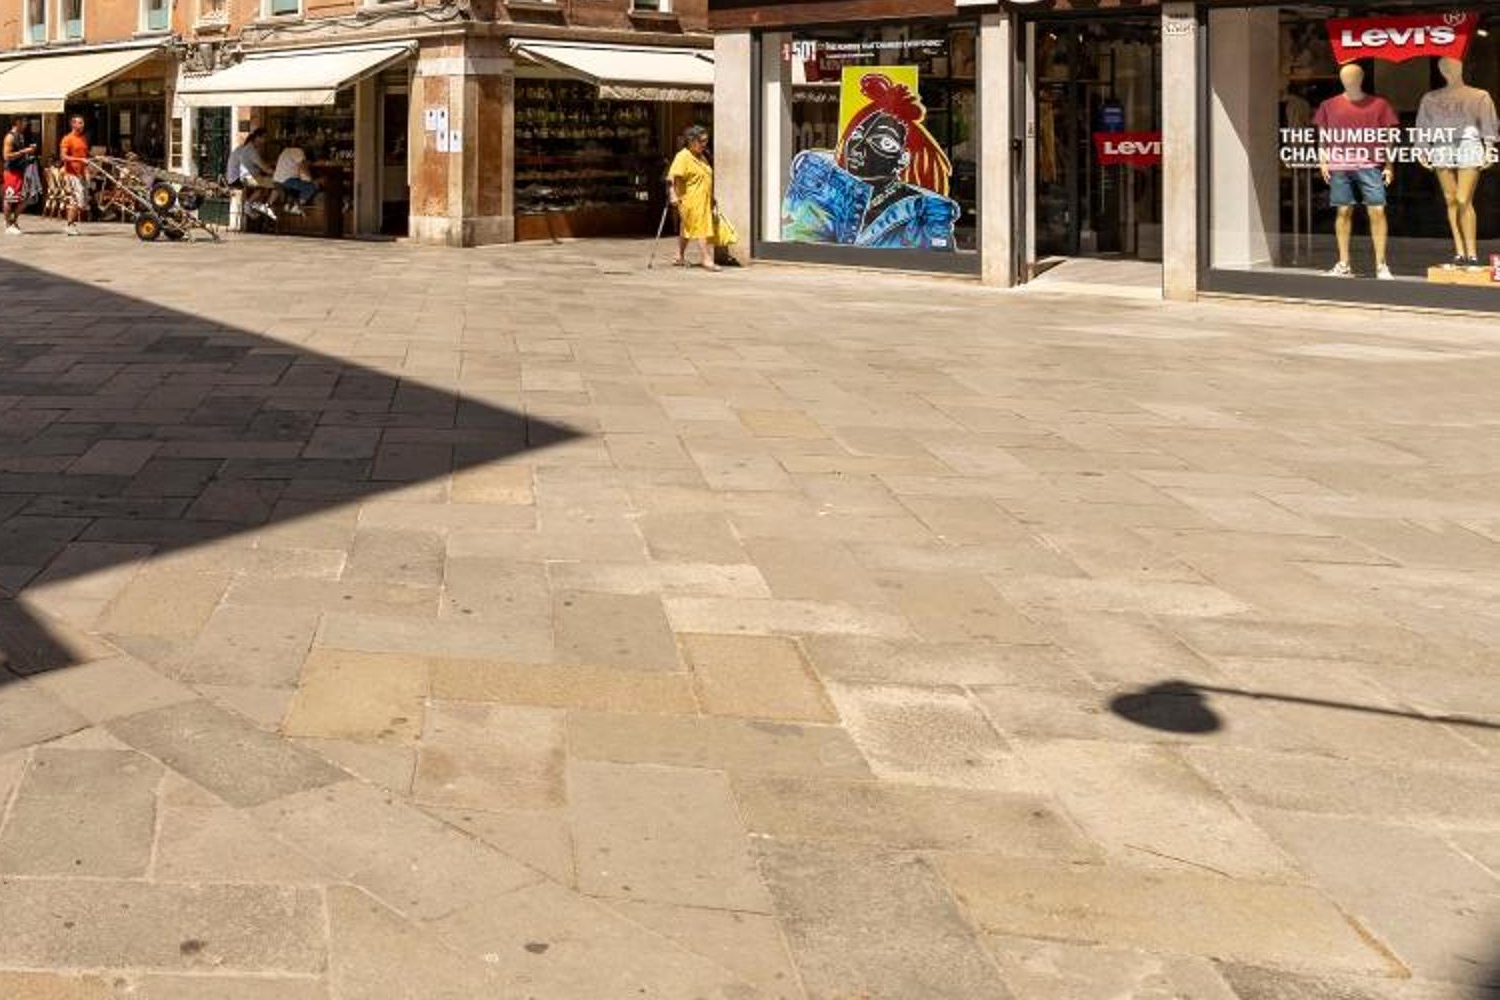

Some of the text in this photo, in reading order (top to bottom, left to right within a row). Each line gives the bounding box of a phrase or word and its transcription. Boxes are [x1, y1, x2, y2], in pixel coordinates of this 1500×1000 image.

[1280, 127, 1456, 143] THE NUMBER THAT
[1103, 141, 1163, 155] Levi
[1280, 146, 1369, 162] CHANGED
